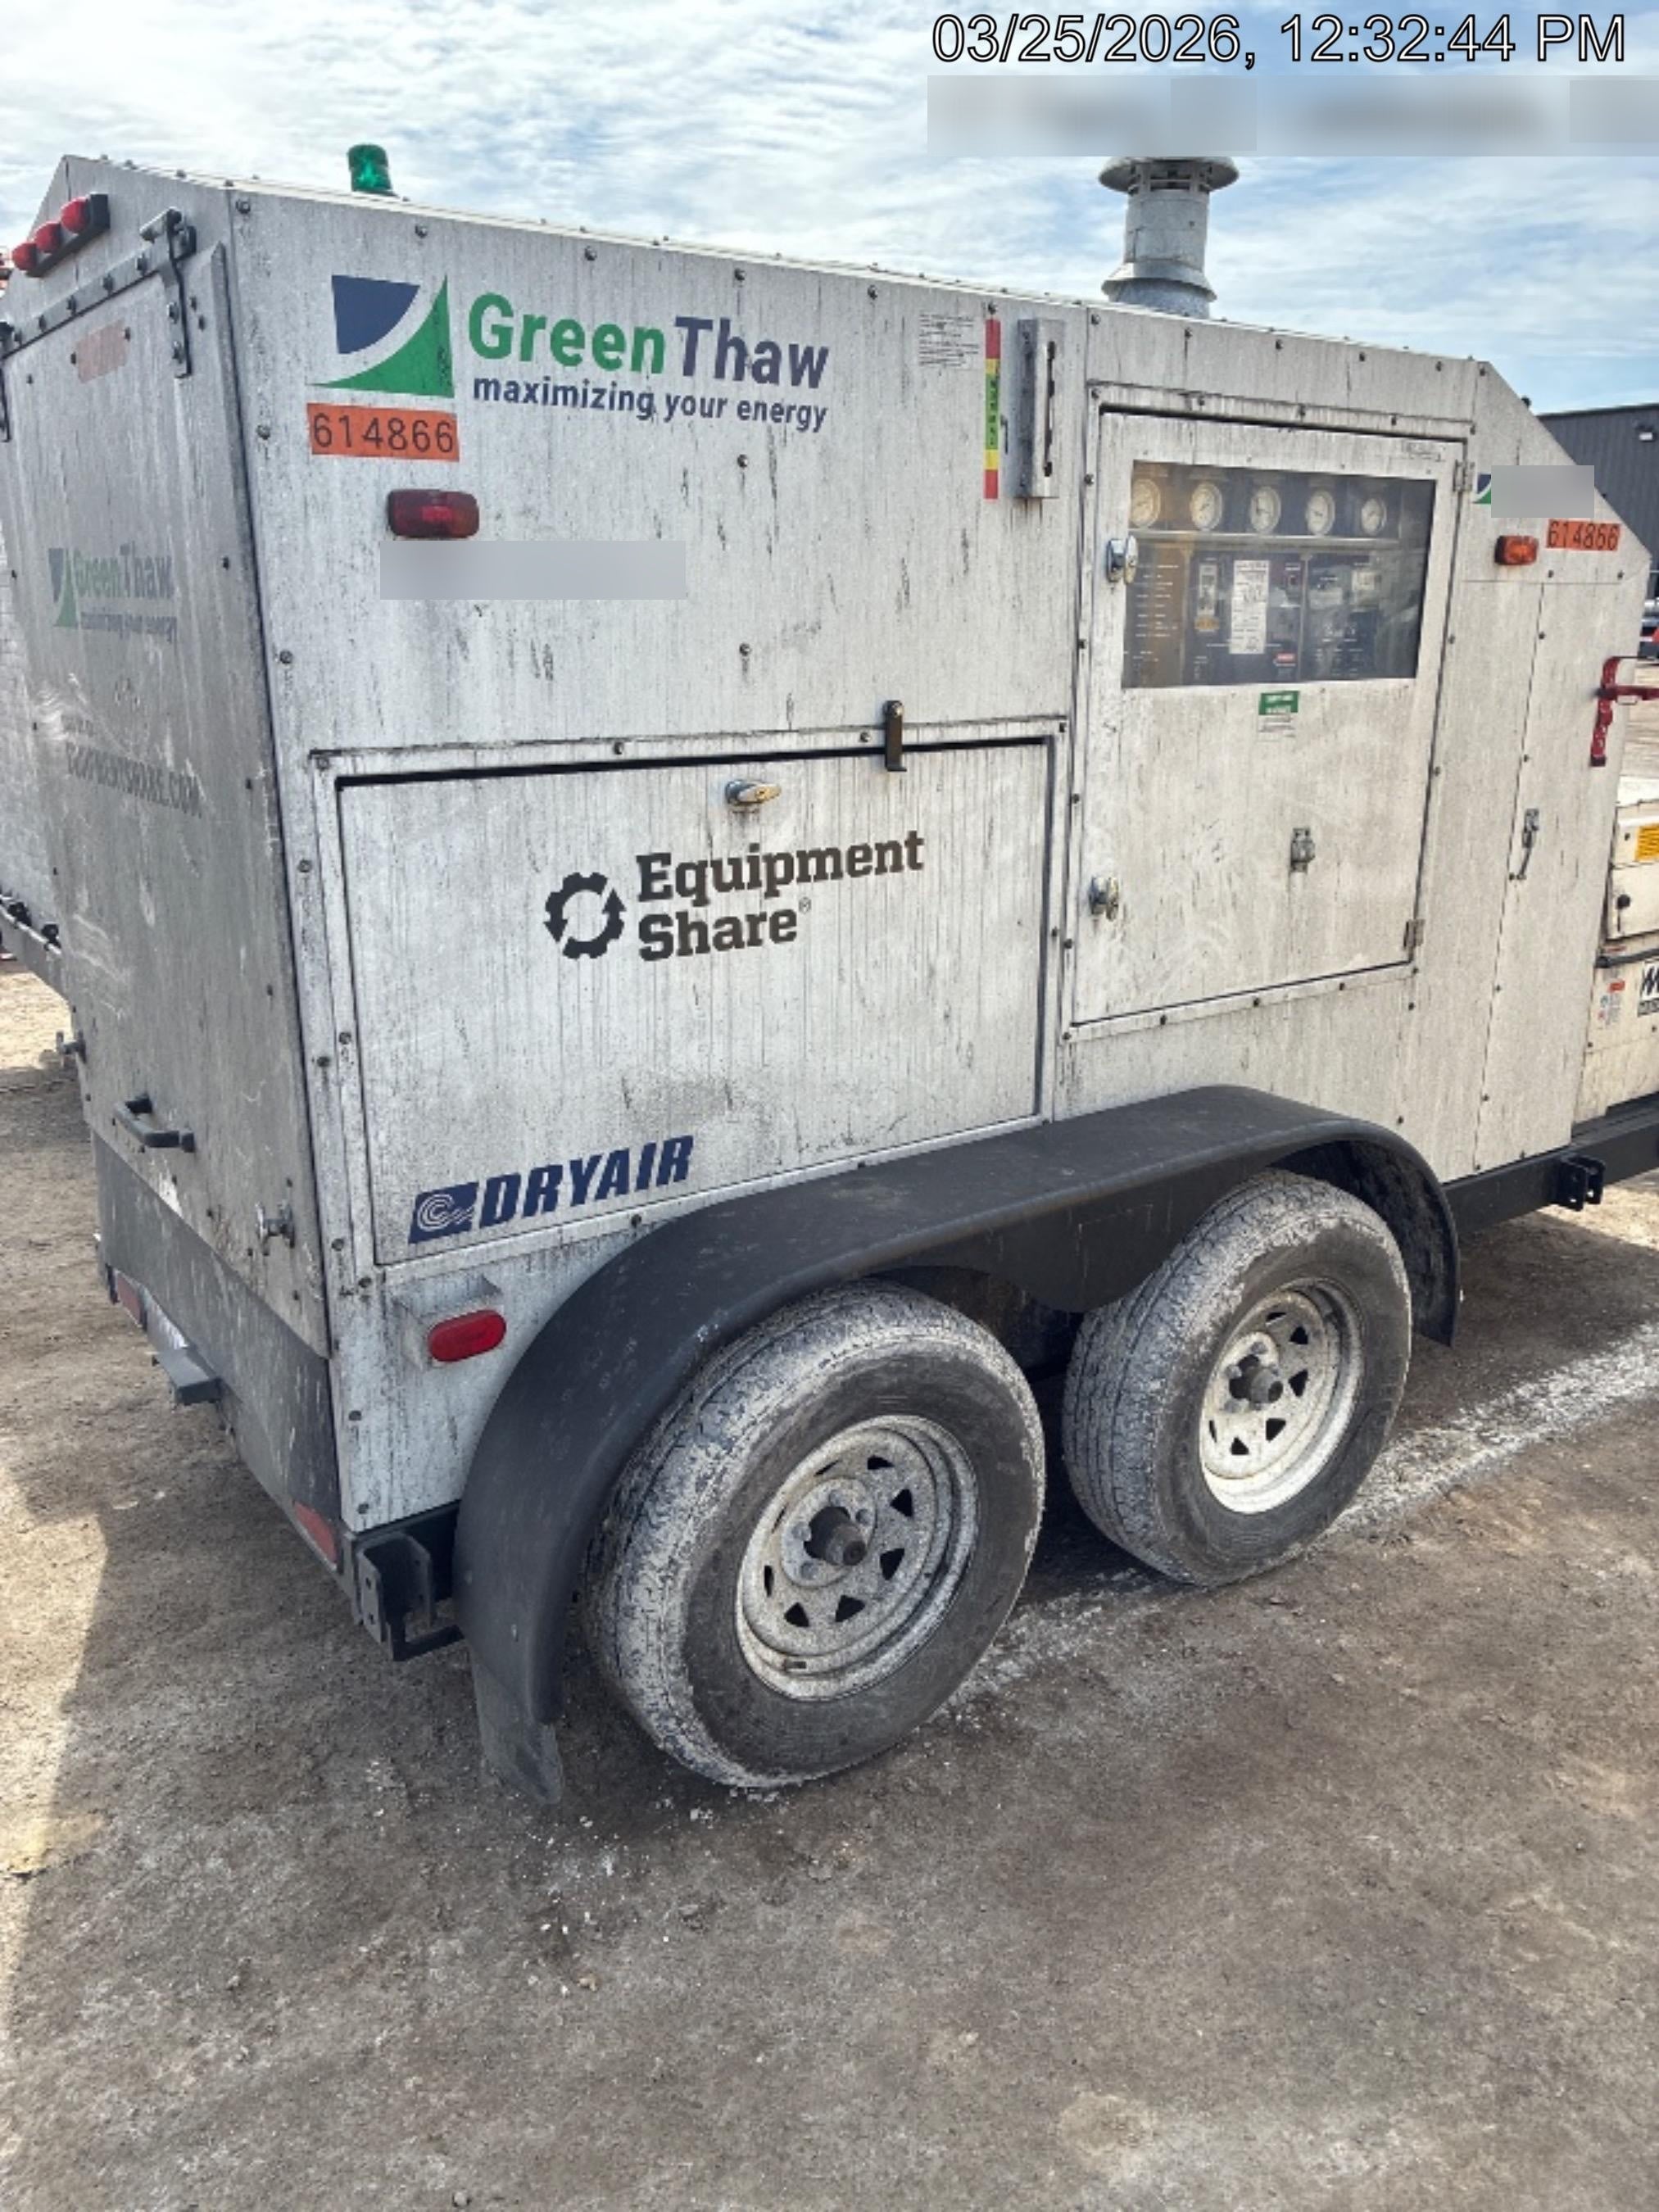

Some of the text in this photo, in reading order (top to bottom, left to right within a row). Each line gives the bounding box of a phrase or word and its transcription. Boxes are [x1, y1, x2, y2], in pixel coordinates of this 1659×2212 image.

[468, 292, 829, 389] GreenThaw
[313, 412, 453, 453] 614866
[473, 374, 827, 433] maximizing your energy
[1547, 519, 1619, 549] 614866
[636, 830, 924, 907] Equipment
[479, 1135, 693, 1228] DRYAIR
